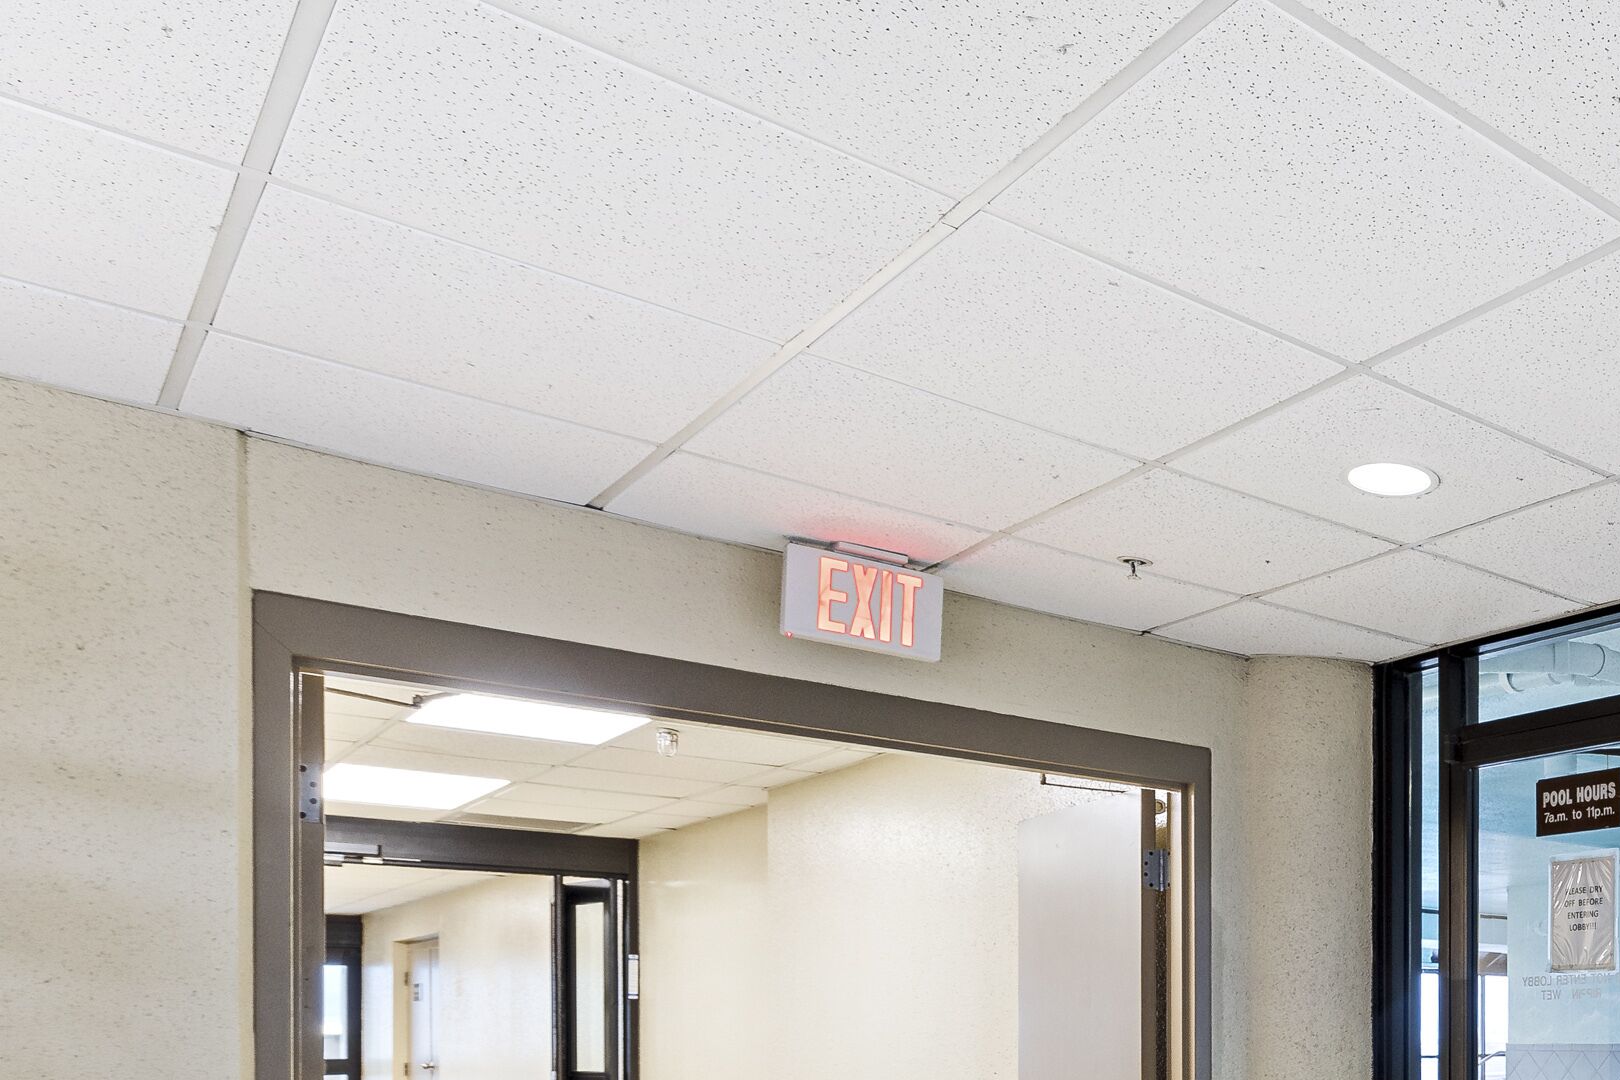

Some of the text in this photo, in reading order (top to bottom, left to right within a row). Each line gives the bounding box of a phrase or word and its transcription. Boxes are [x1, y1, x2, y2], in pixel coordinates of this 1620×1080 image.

[817, 556, 923, 648] EXIT
[1542, 781, 1616, 808] POOL HOURS
[1544, 805, 1615, 823] 7a.m. to 11p.m.
[1589, 885, 1603, 894] DRY
[1564, 897, 1604, 907] OFF BEFORE
